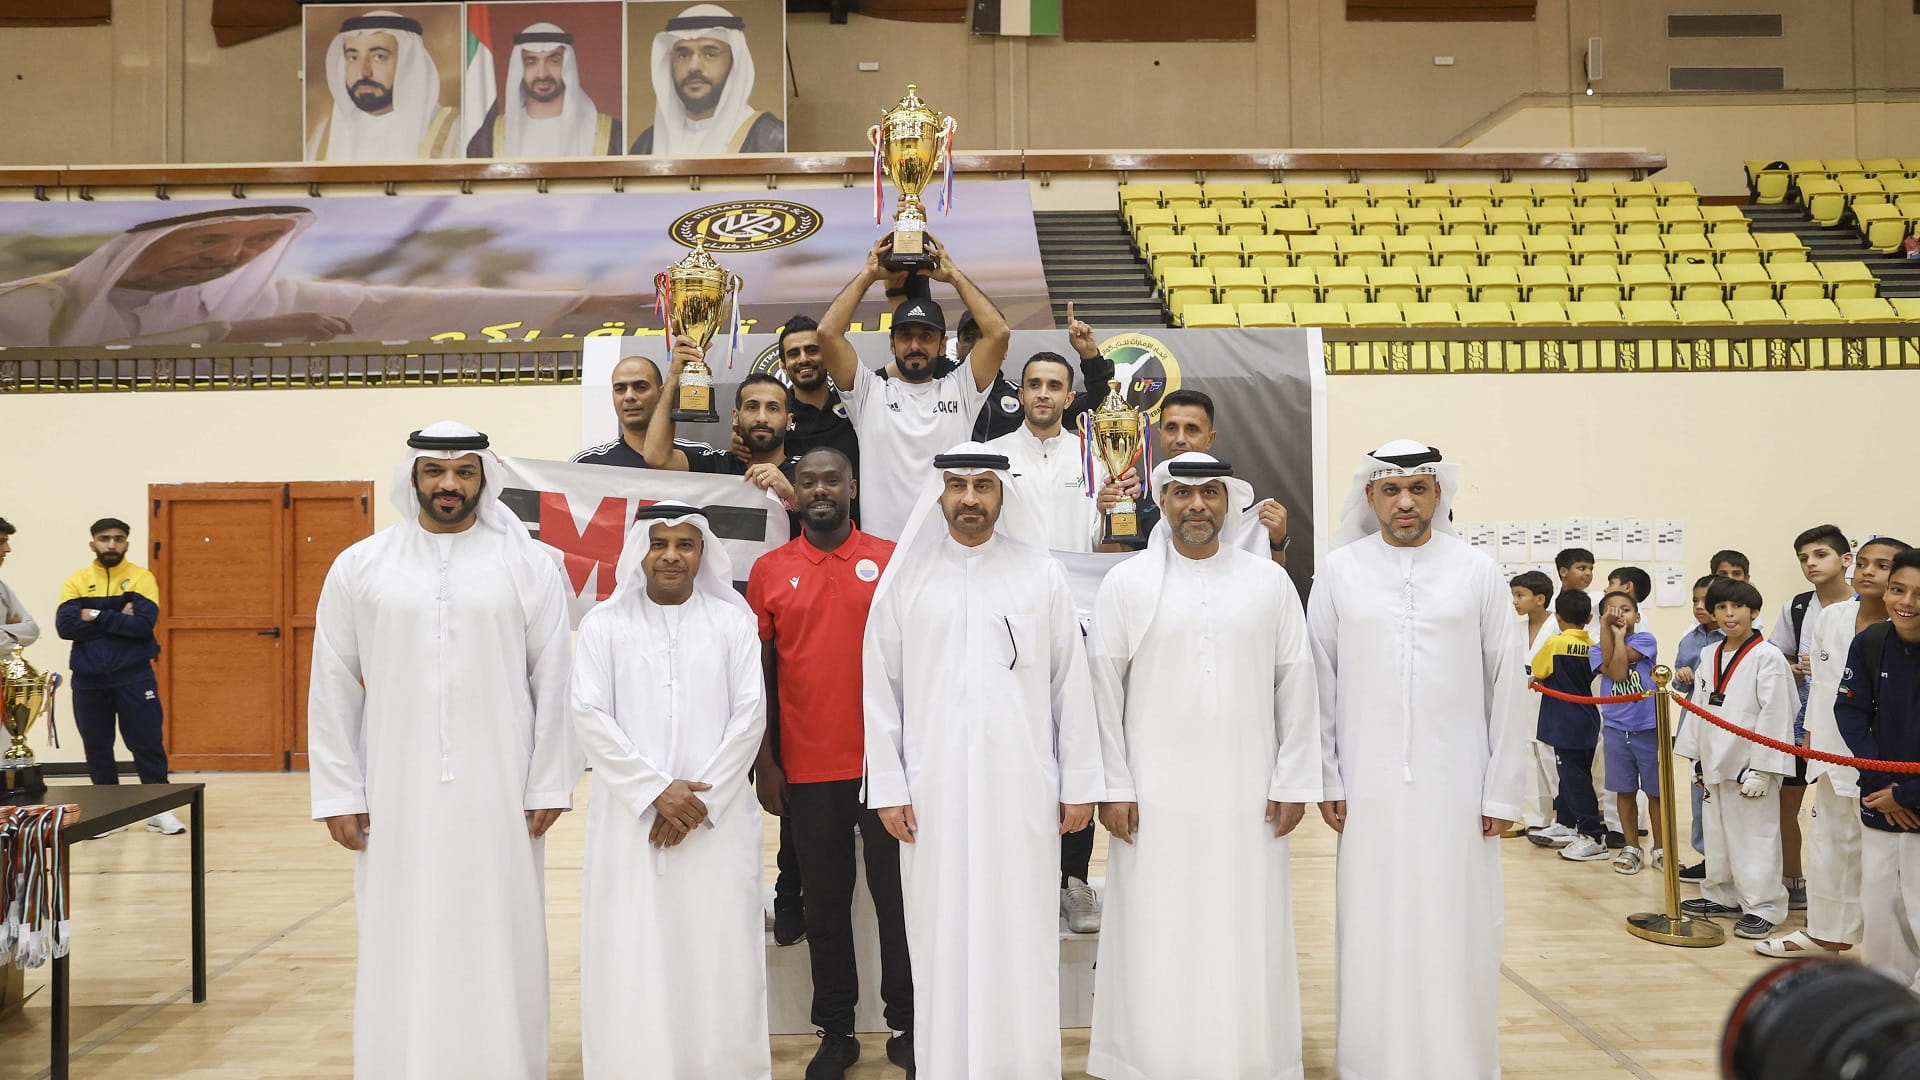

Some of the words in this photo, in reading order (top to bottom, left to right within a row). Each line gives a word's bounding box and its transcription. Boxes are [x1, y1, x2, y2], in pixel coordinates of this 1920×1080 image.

[693, 204, 742, 219] ITTIHAD
[758, 349, 780, 370] ITTIH
[1134, 378, 1162, 393] UTF
